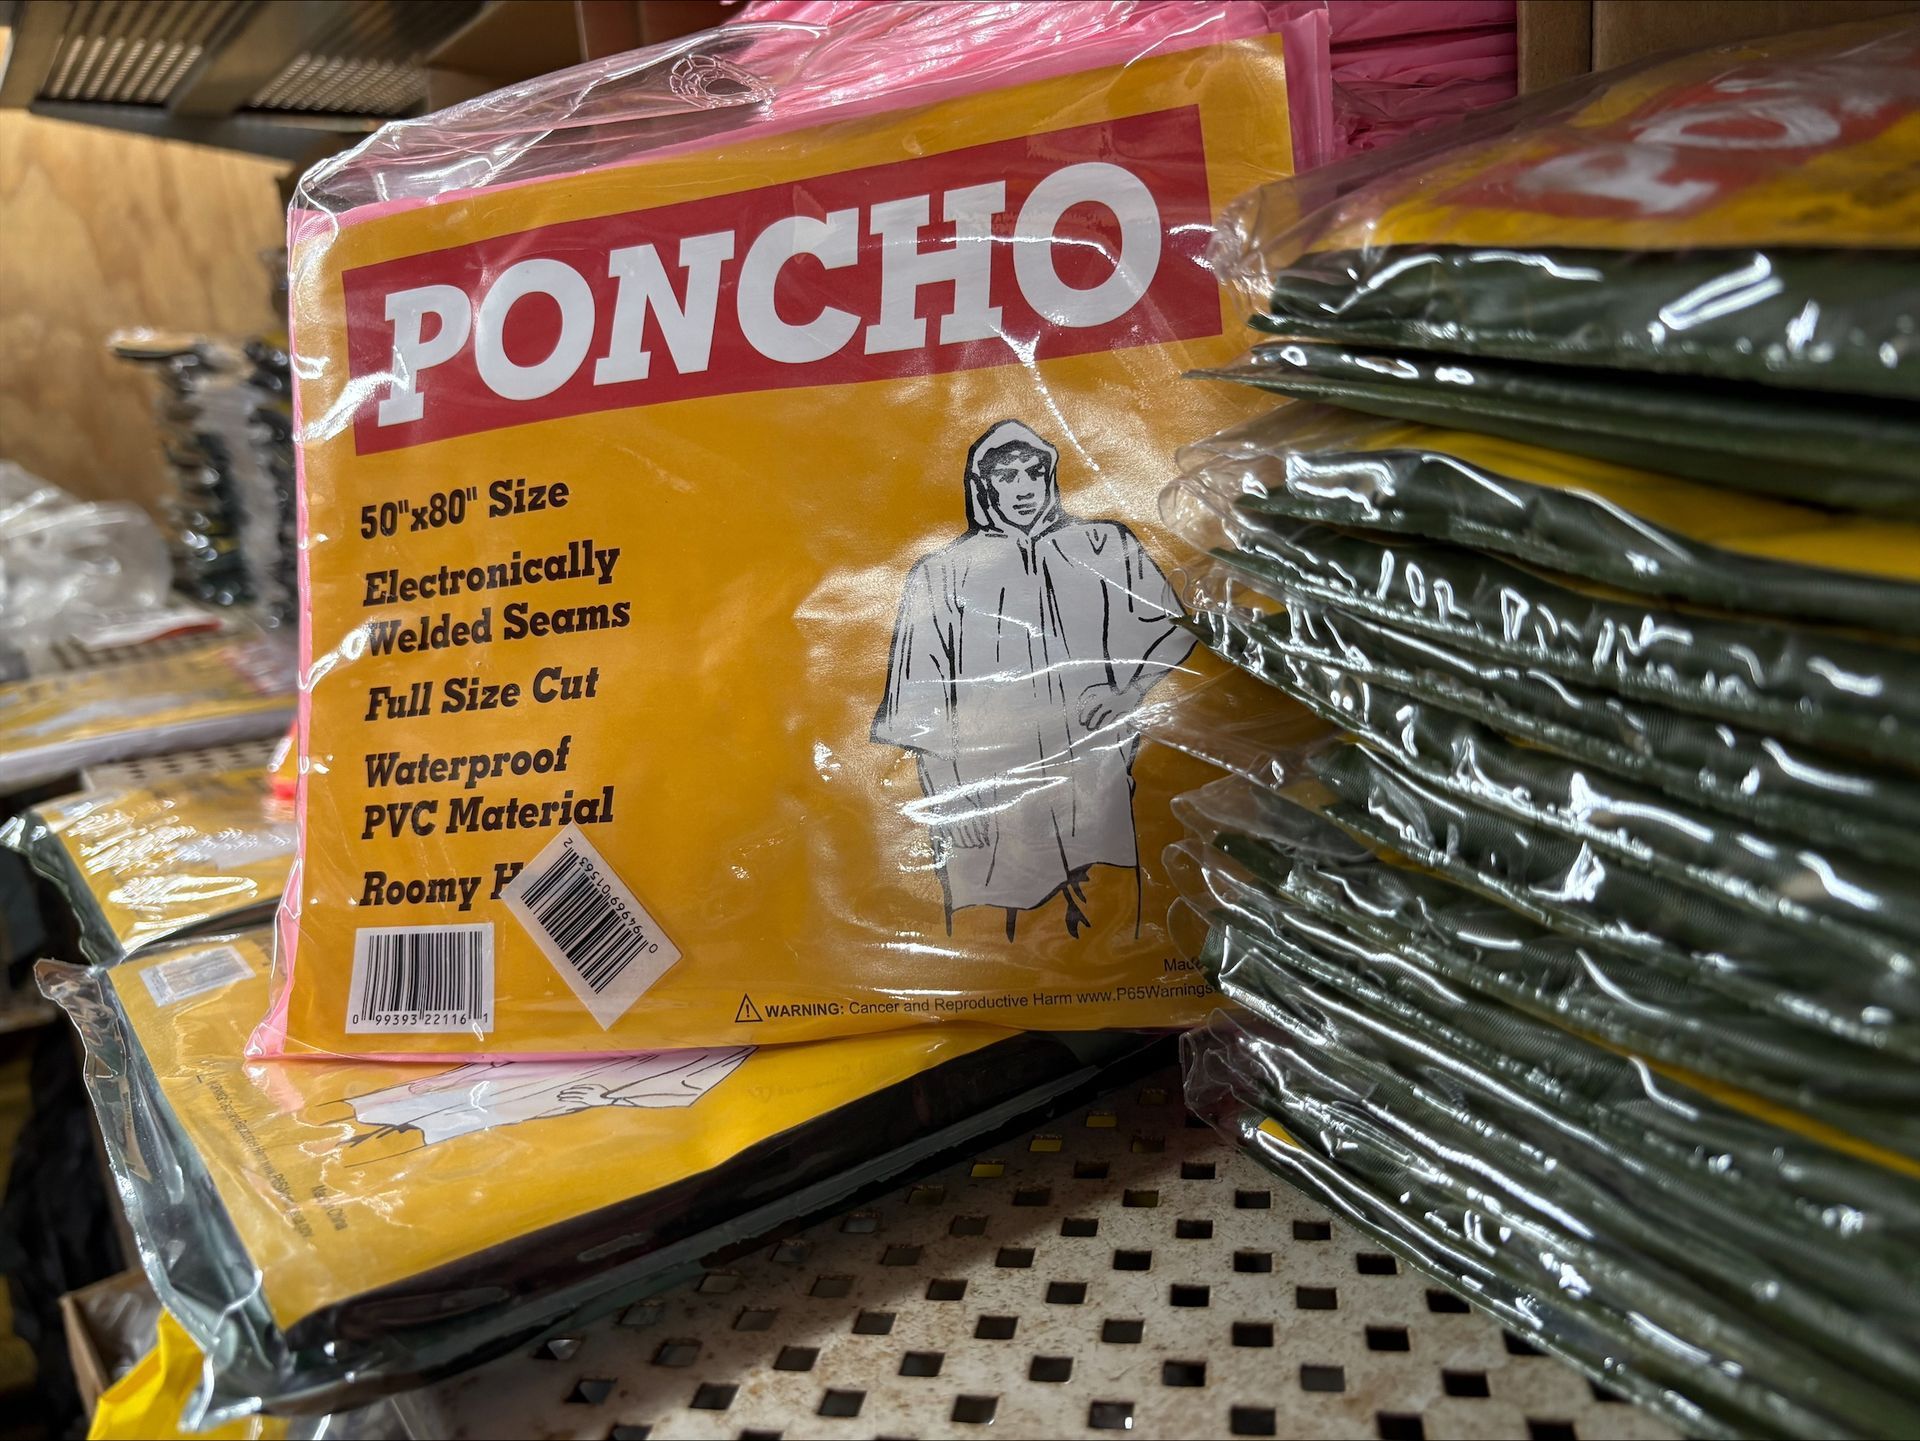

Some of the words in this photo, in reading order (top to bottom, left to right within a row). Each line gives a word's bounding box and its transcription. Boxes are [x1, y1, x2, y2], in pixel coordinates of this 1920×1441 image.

[377, 161, 1162, 428] PONCHO
[360, 485, 478, 540] 50"x80"
[488, 478, 569, 518] Size
[363, 540, 620, 607] Electronically
[366, 608, 492, 657] Welded
[503, 599, 631, 640] Seams
[365, 682, 433, 721] Full
[441, 676, 520, 714] Size
[533, 666, 599, 703] Cut
[365, 736, 571, 789] Waterproof
[361, 799, 438, 840] PVC
[446, 786, 614, 834] Material
[359, 871, 481, 911] Roomy
[578, 857, 612, 895] 01563
[610, 896, 642, 935] 94969
[375, 1014, 418, 1026] 99393
[424, 1014, 467, 1025] 22116
[765, 1002, 844, 1018] WARNING:
[849, 1000, 899, 1015] Cancer
[904, 998, 930, 1012] and
[935, 994, 1028, 1012] Reproductive
[1033, 991, 1072, 1006] Harm
